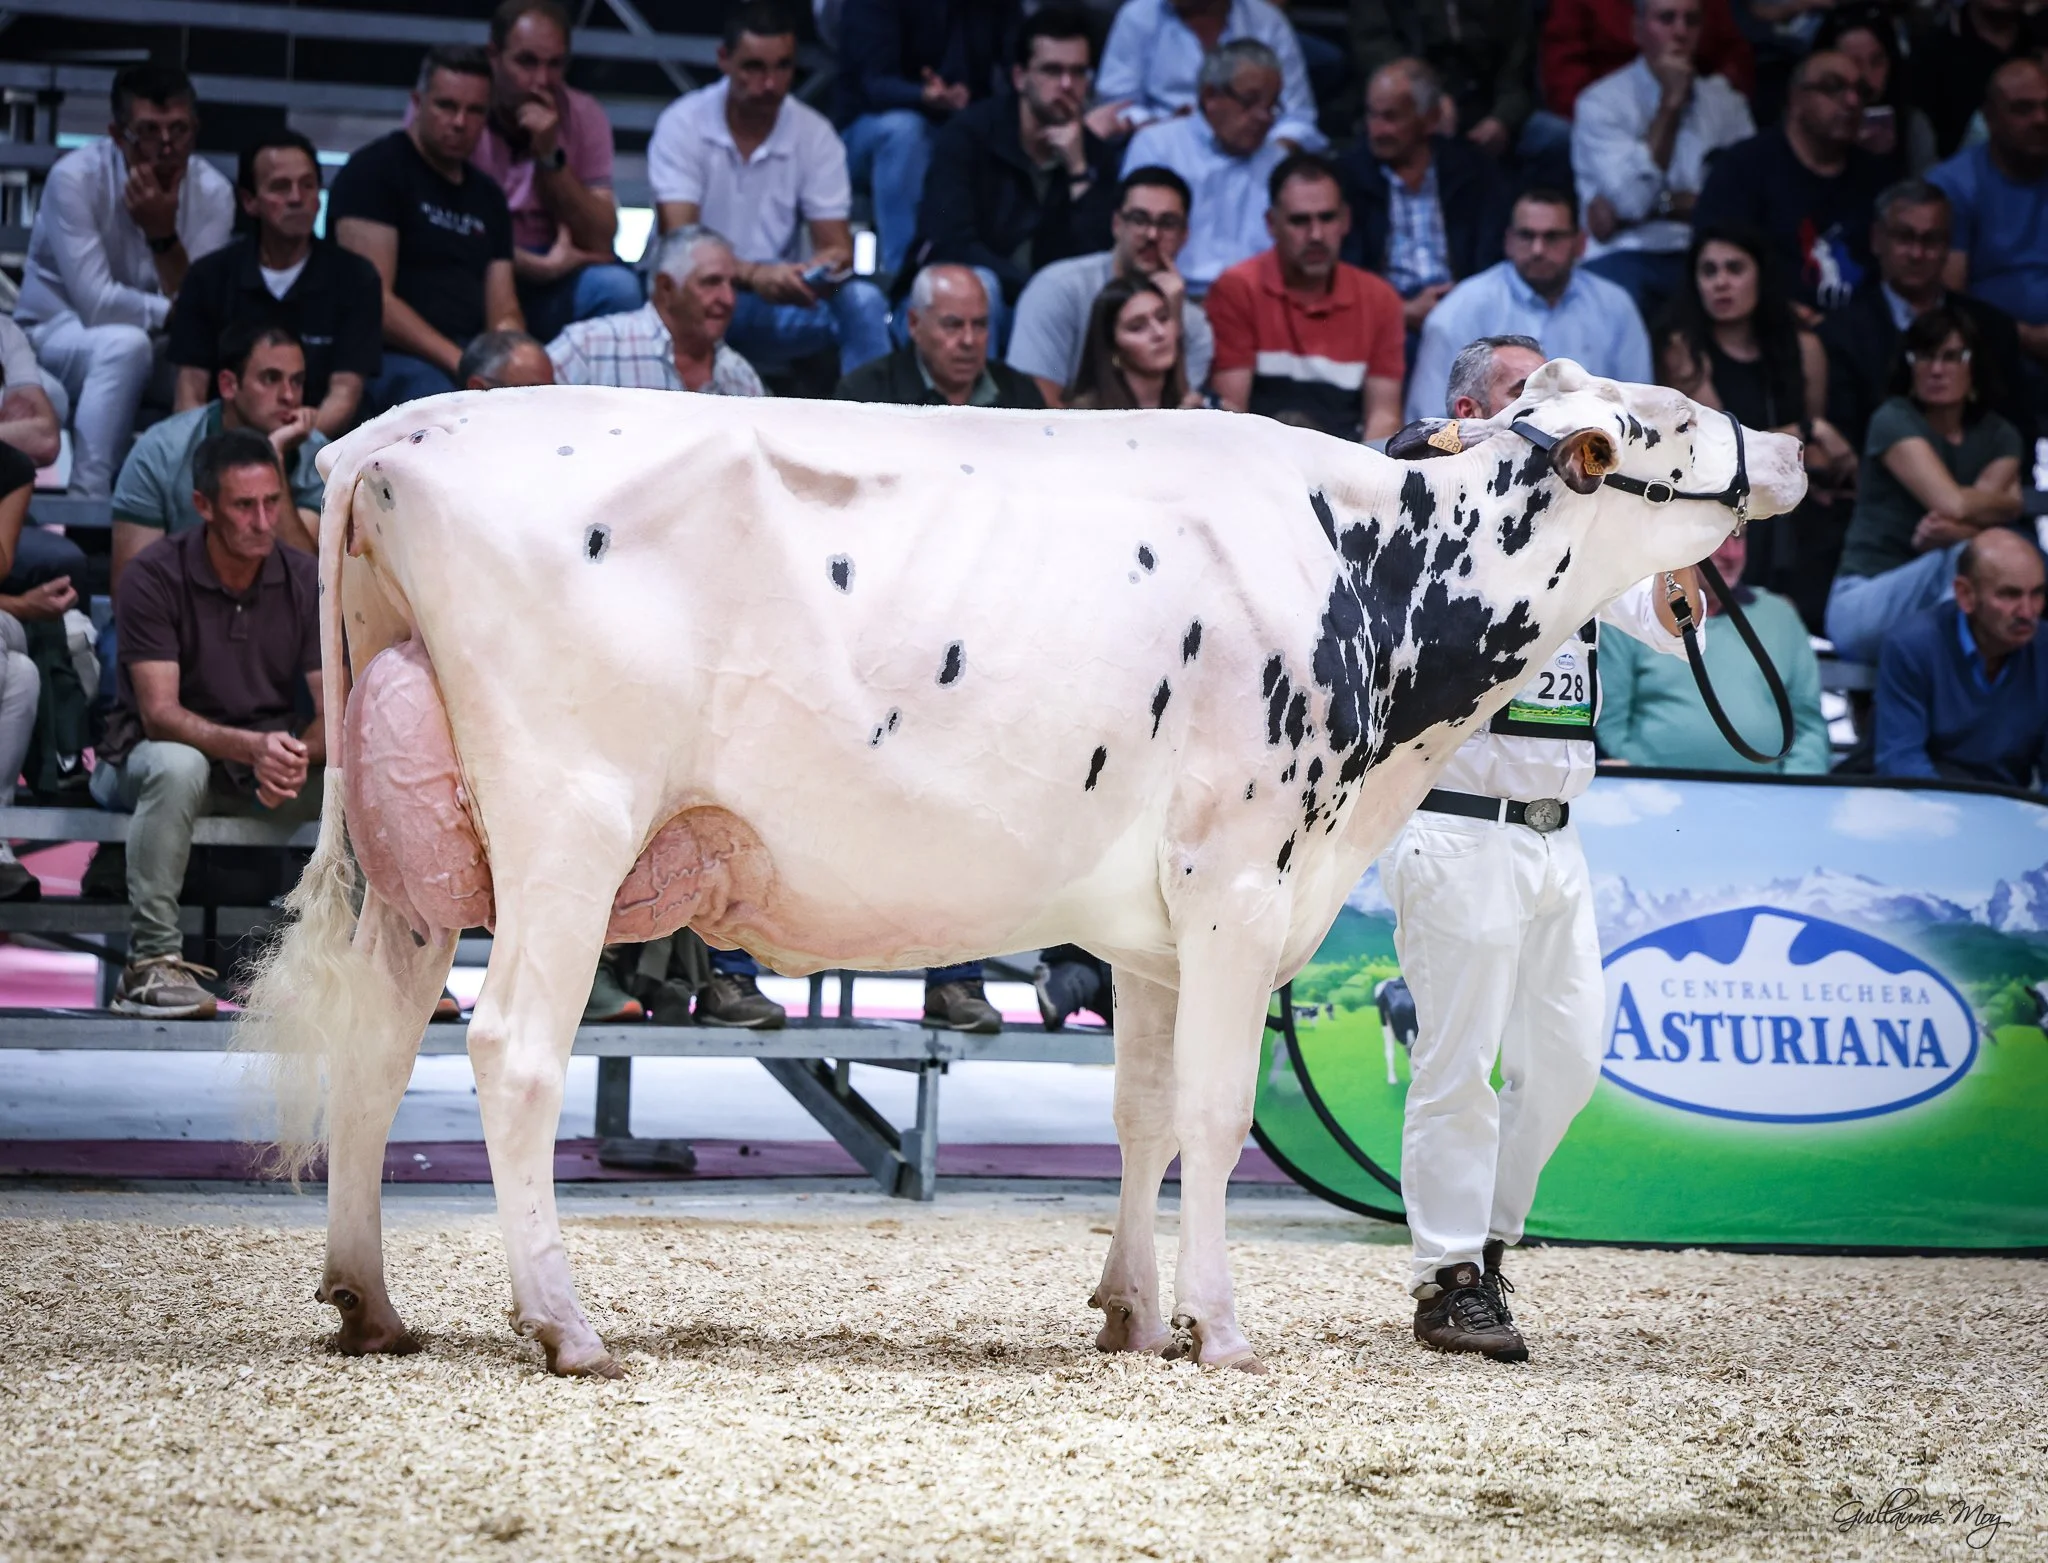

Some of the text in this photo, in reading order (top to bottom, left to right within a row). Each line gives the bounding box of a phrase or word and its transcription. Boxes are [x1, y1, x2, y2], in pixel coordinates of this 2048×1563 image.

[1431, 434, 1460, 452] 7628
[1538, 671, 1584, 702] 228
[1660, 978, 1931, 1005] CENTRAL LECHERA
[1603, 981, 1951, 1069] ASTURIANA
